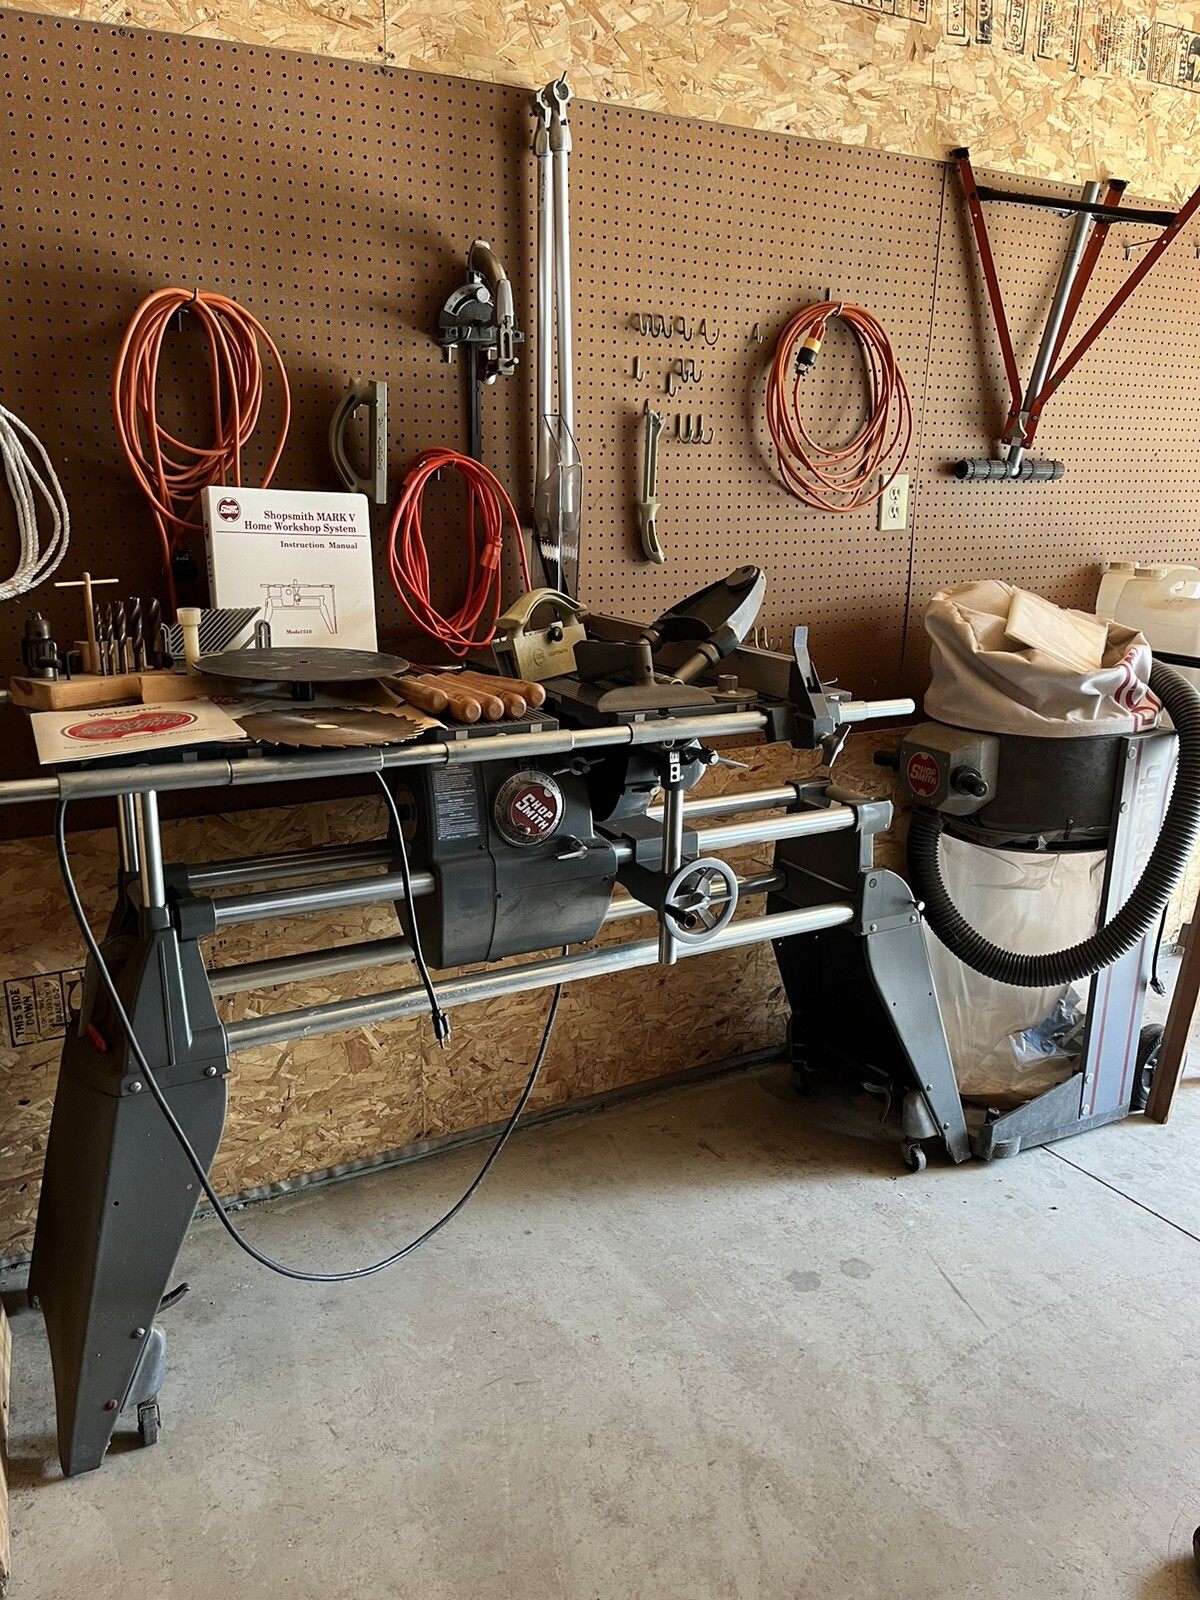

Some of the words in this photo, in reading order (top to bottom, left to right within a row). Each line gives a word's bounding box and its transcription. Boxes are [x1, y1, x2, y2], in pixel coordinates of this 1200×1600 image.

[263, 510, 315, 522] Shopsmith
[316, 512, 347, 522] MARK
[348, 513, 356, 522] V
[244, 521, 272, 531] Home
[274, 521, 322, 534] Workshop
[323, 523, 357, 534] System
[280, 541, 325, 549] Instruction
[10, 988, 23, 1011] SIDE
[23, 995, 34, 1026] DOWN
[13, 1014, 25, 1037] THIS
